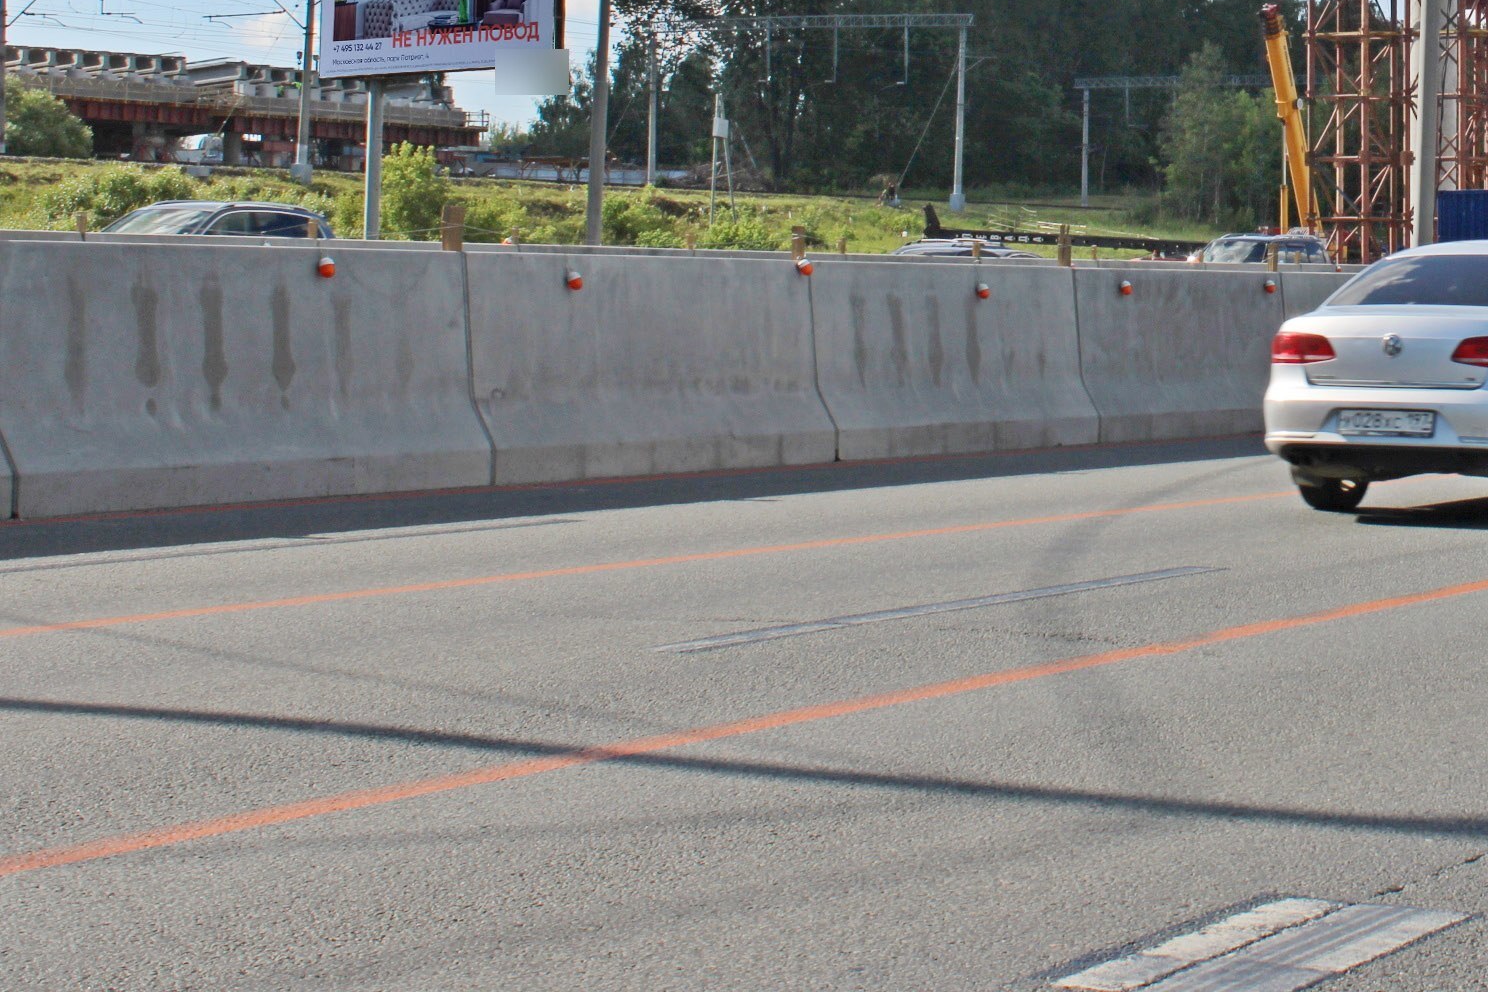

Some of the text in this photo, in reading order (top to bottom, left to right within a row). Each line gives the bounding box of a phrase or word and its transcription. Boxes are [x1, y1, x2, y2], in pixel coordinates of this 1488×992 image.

[392, 21, 540, 48] НЕ НУЖЕН ПОВОД
[333, 45, 340, 53] +7
[341, 44, 353, 52] 495
[354, 43, 364, 51] 132
[375, 41, 382, 50] 27
